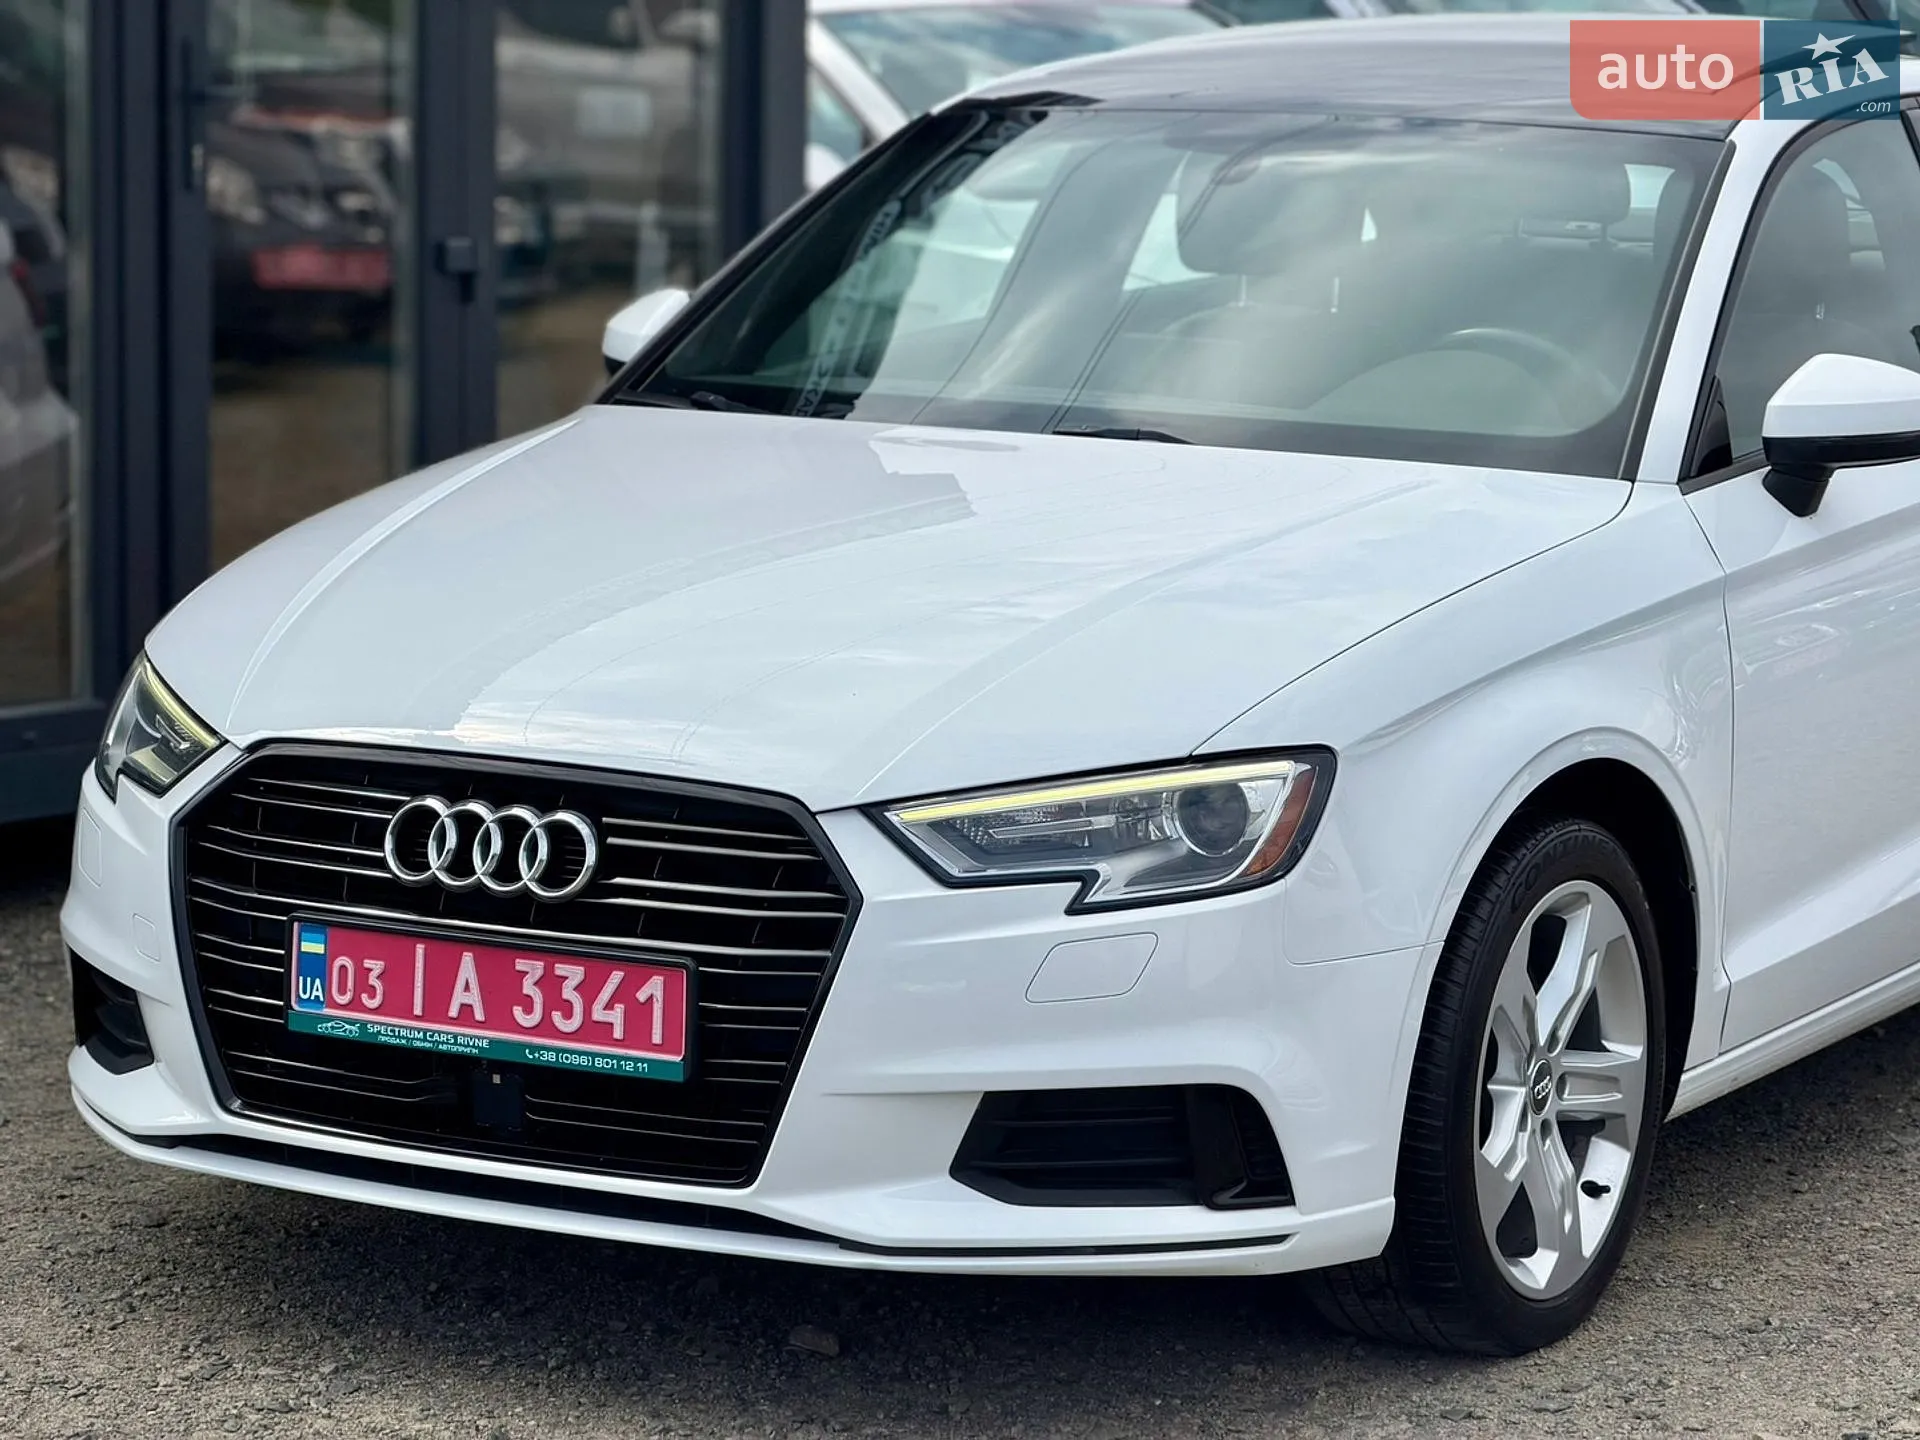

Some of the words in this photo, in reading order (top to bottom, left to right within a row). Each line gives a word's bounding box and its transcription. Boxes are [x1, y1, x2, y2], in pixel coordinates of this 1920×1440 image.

[298, 976, 324, 1002] UA
[331, 955, 385, 1010] 03
[512, 957, 665, 1045] 3341
[367, 1023, 424, 1040] SPECTRUM
[427, 1031, 455, 1044] CARS
[457, 1035, 491, 1048] RIVNE
[534, 1050, 556, 1062] +38
[594, 1057, 617, 1069] 801
[620, 1060, 634, 1071] 12
[636, 1062, 649, 1073] 11
